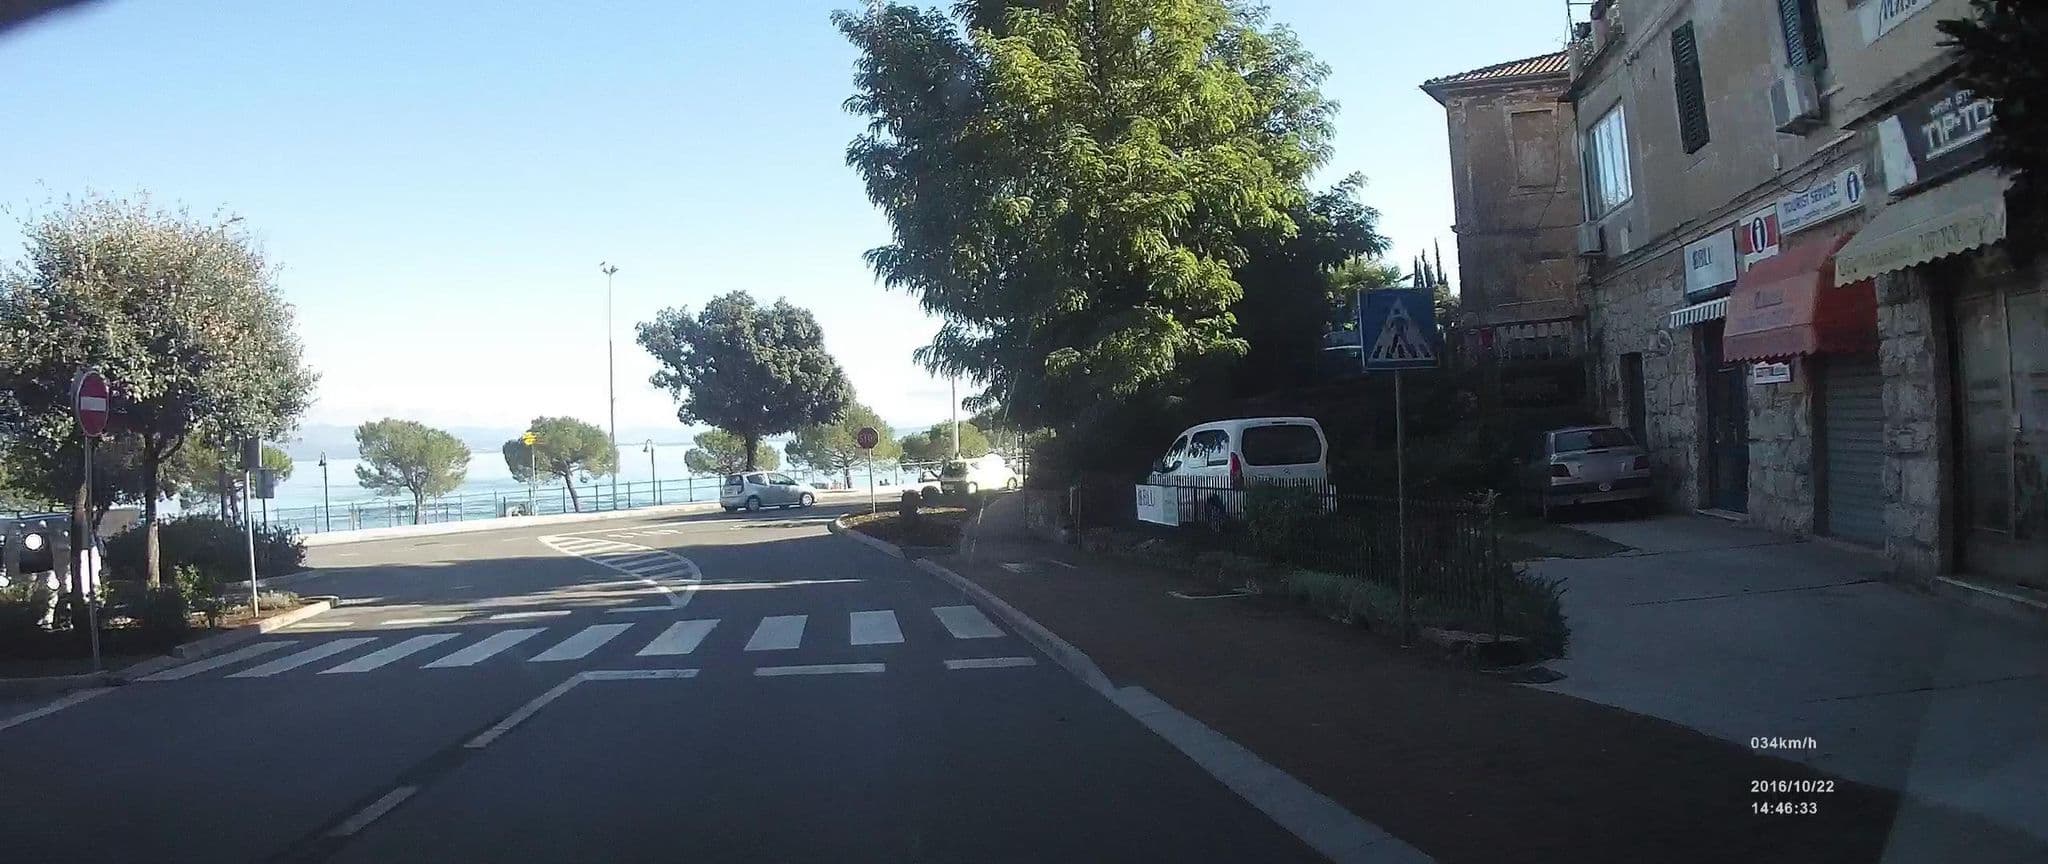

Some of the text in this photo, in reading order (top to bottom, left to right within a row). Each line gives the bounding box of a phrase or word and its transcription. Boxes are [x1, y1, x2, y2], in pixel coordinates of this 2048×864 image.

[1921, 98, 1996, 150] TIP-TO
[1783, 193, 1810, 215] TOURIST
[1810, 179, 1838, 204] SERVICE
